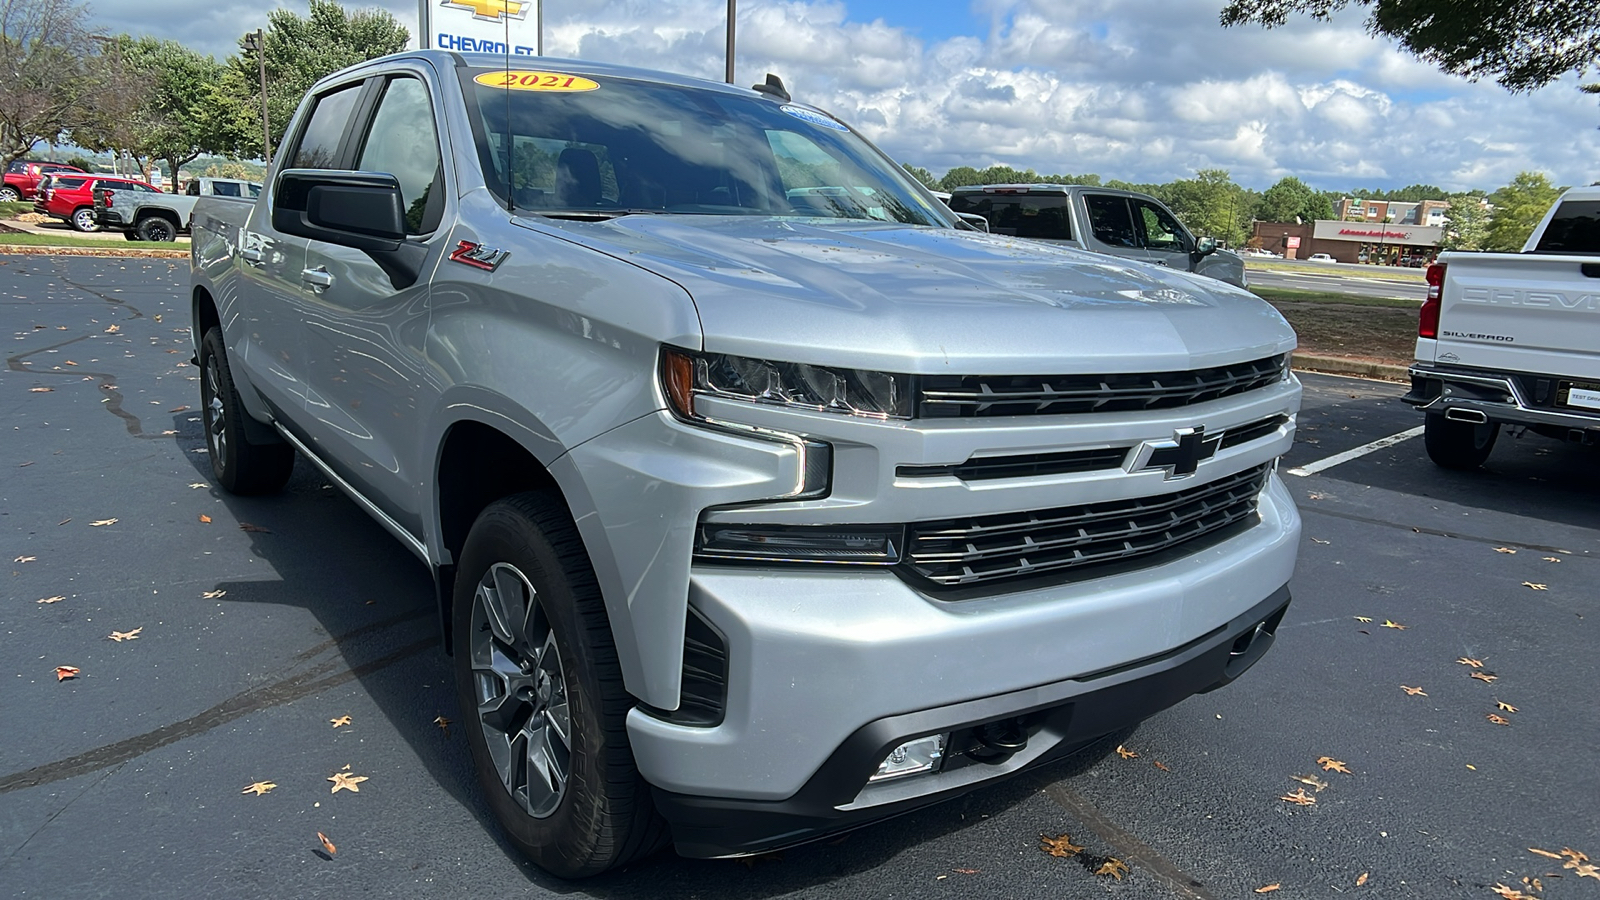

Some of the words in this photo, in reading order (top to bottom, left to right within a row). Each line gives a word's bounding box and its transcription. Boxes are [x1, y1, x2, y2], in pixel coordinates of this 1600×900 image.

[498, 73, 576, 88] 2021
[448, 239, 511, 273] Z71
[1442, 330, 1514, 342] SILVERADO
